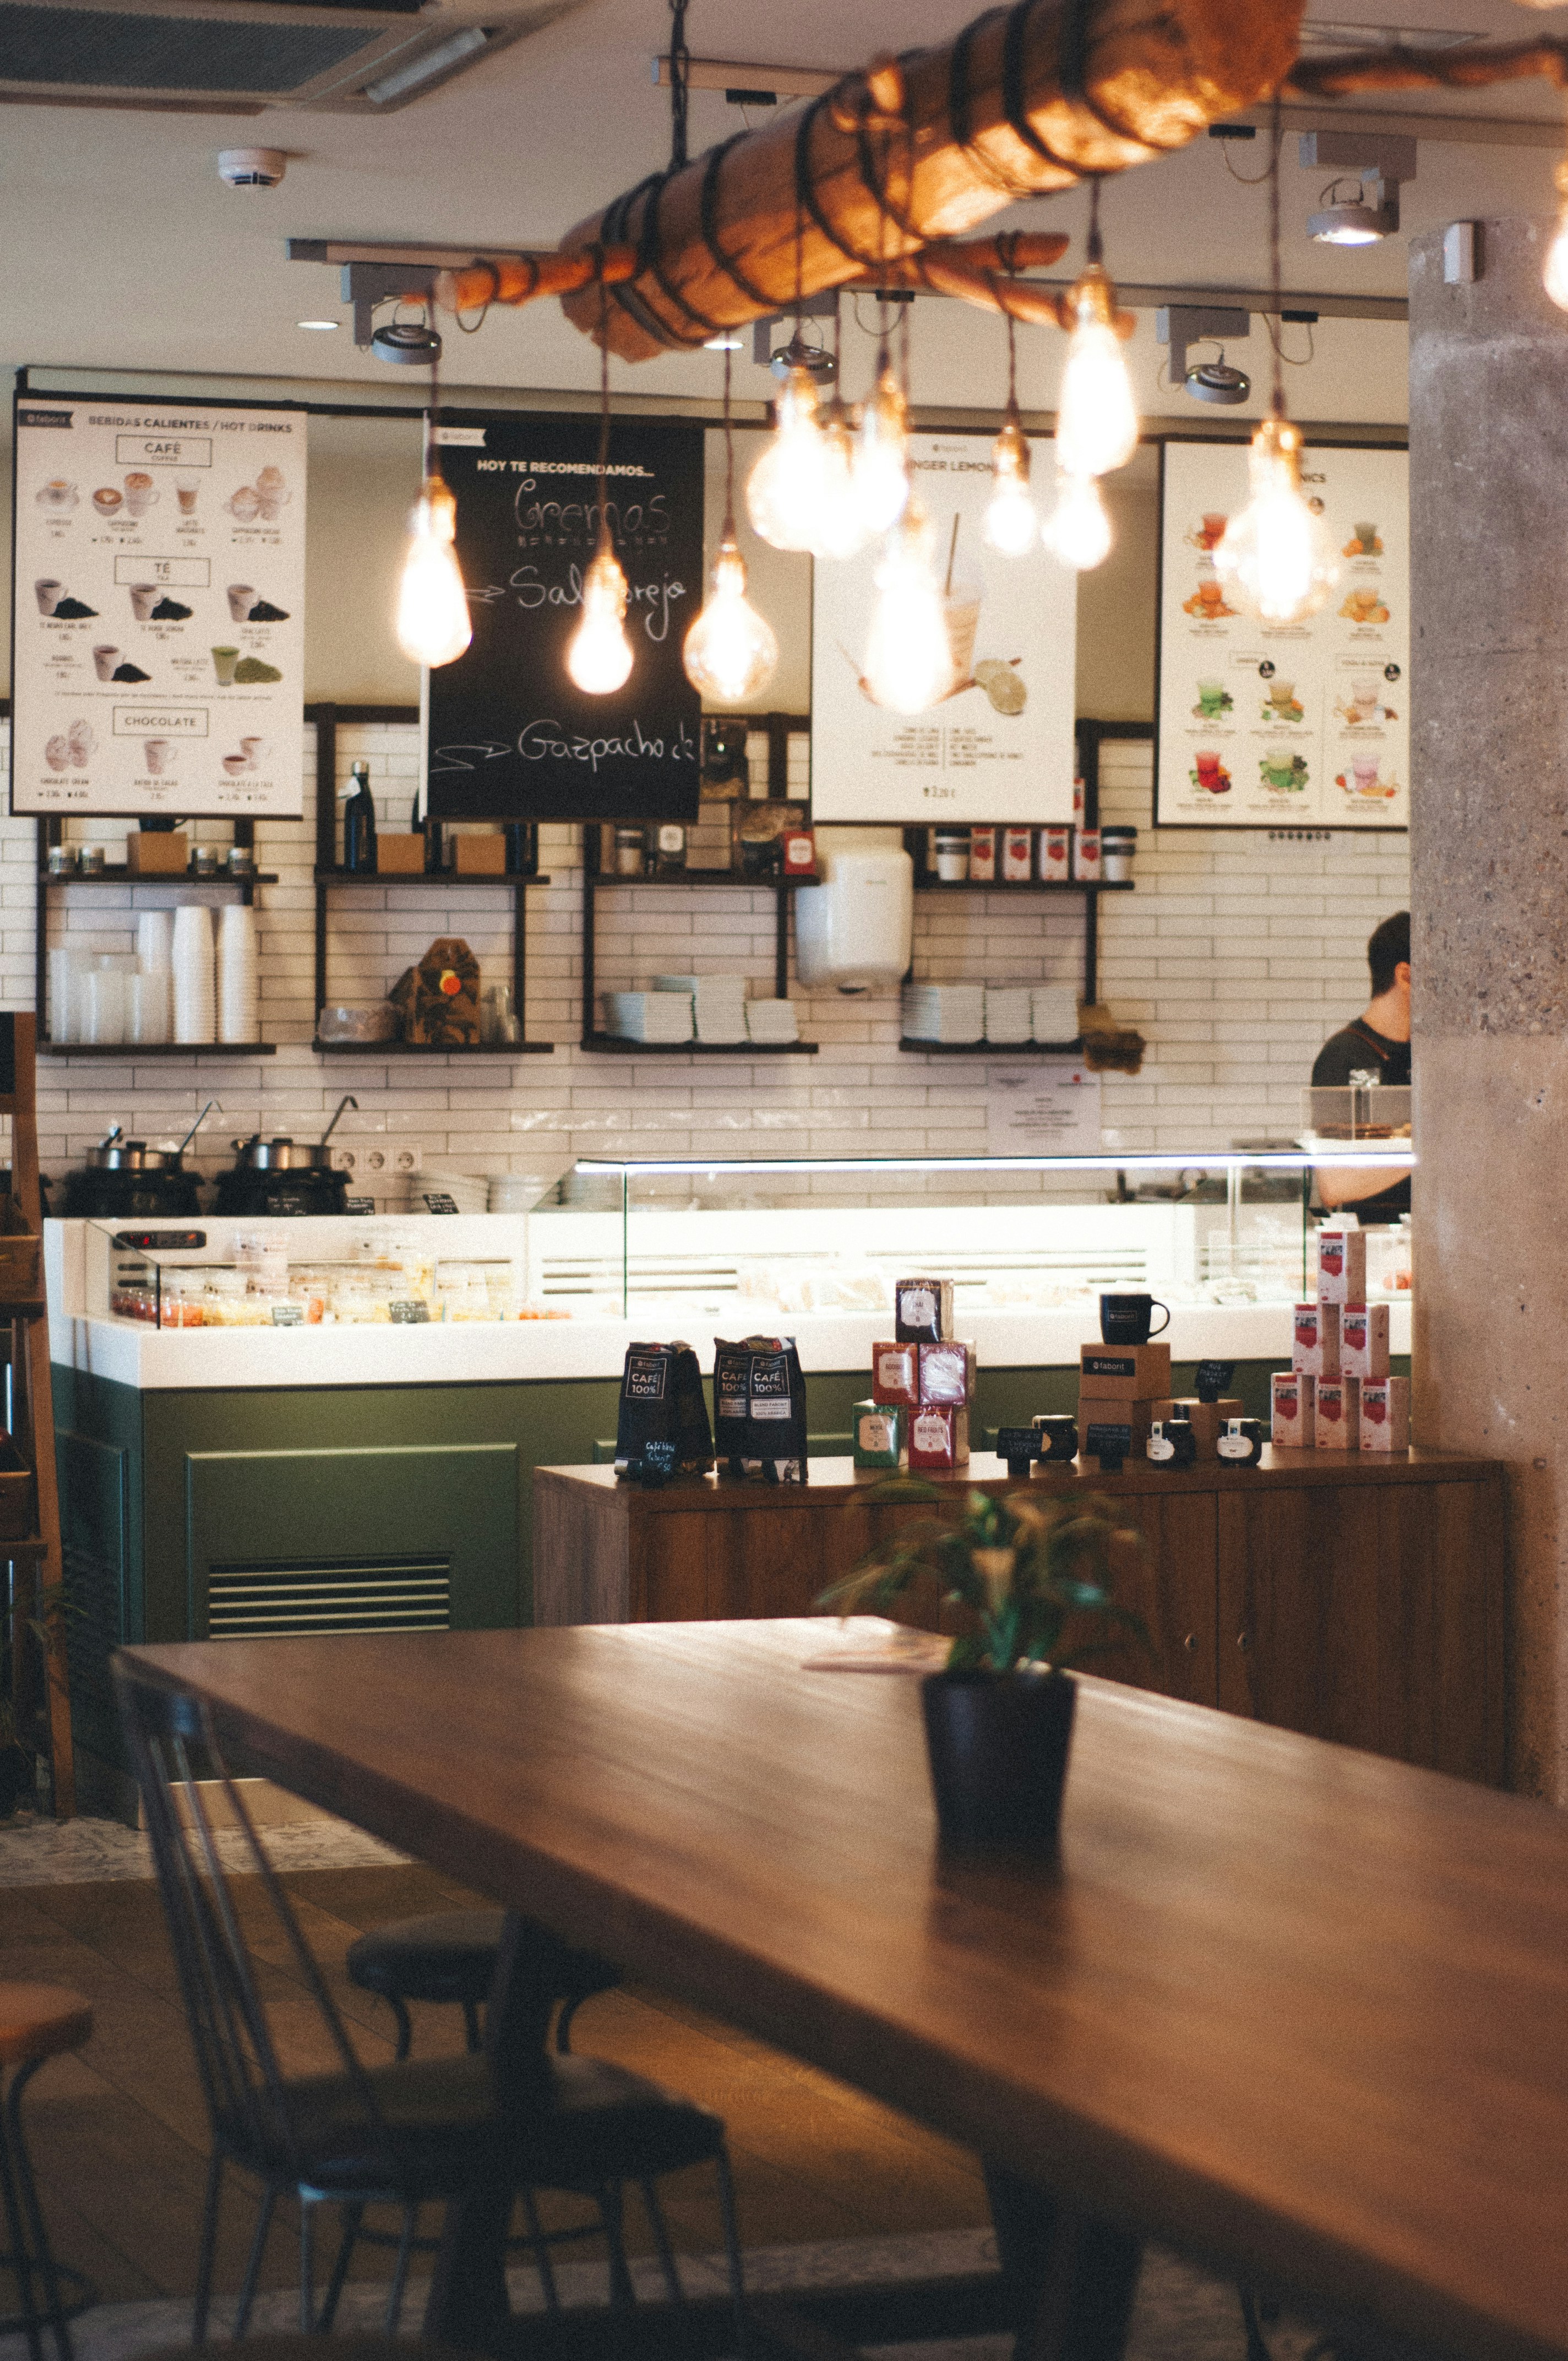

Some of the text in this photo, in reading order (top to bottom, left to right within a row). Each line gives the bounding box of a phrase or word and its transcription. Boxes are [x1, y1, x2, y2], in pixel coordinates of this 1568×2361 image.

[89, 416, 292, 433] BEBIDAS CALIENTES / HOT DRINKS
[144, 442, 181, 454] CAFÉ
[477, 459, 507, 472] HOY
[510, 460, 527, 472] TE
[154, 561, 170, 574] TÉ
[124, 716, 197, 727] CHOCOLATE
[518, 719, 663, 773] Gazpacho
[1099, 1362, 1125, 1370] faborit
[631, 1373, 657, 1383] CAFÉ
[754, 1370, 781, 1382] CAFÉ
[631, 1384, 656, 1394] 100%
[722, 1383, 747, 1392] 100%
[754, 1383, 782, 1392] 100%
